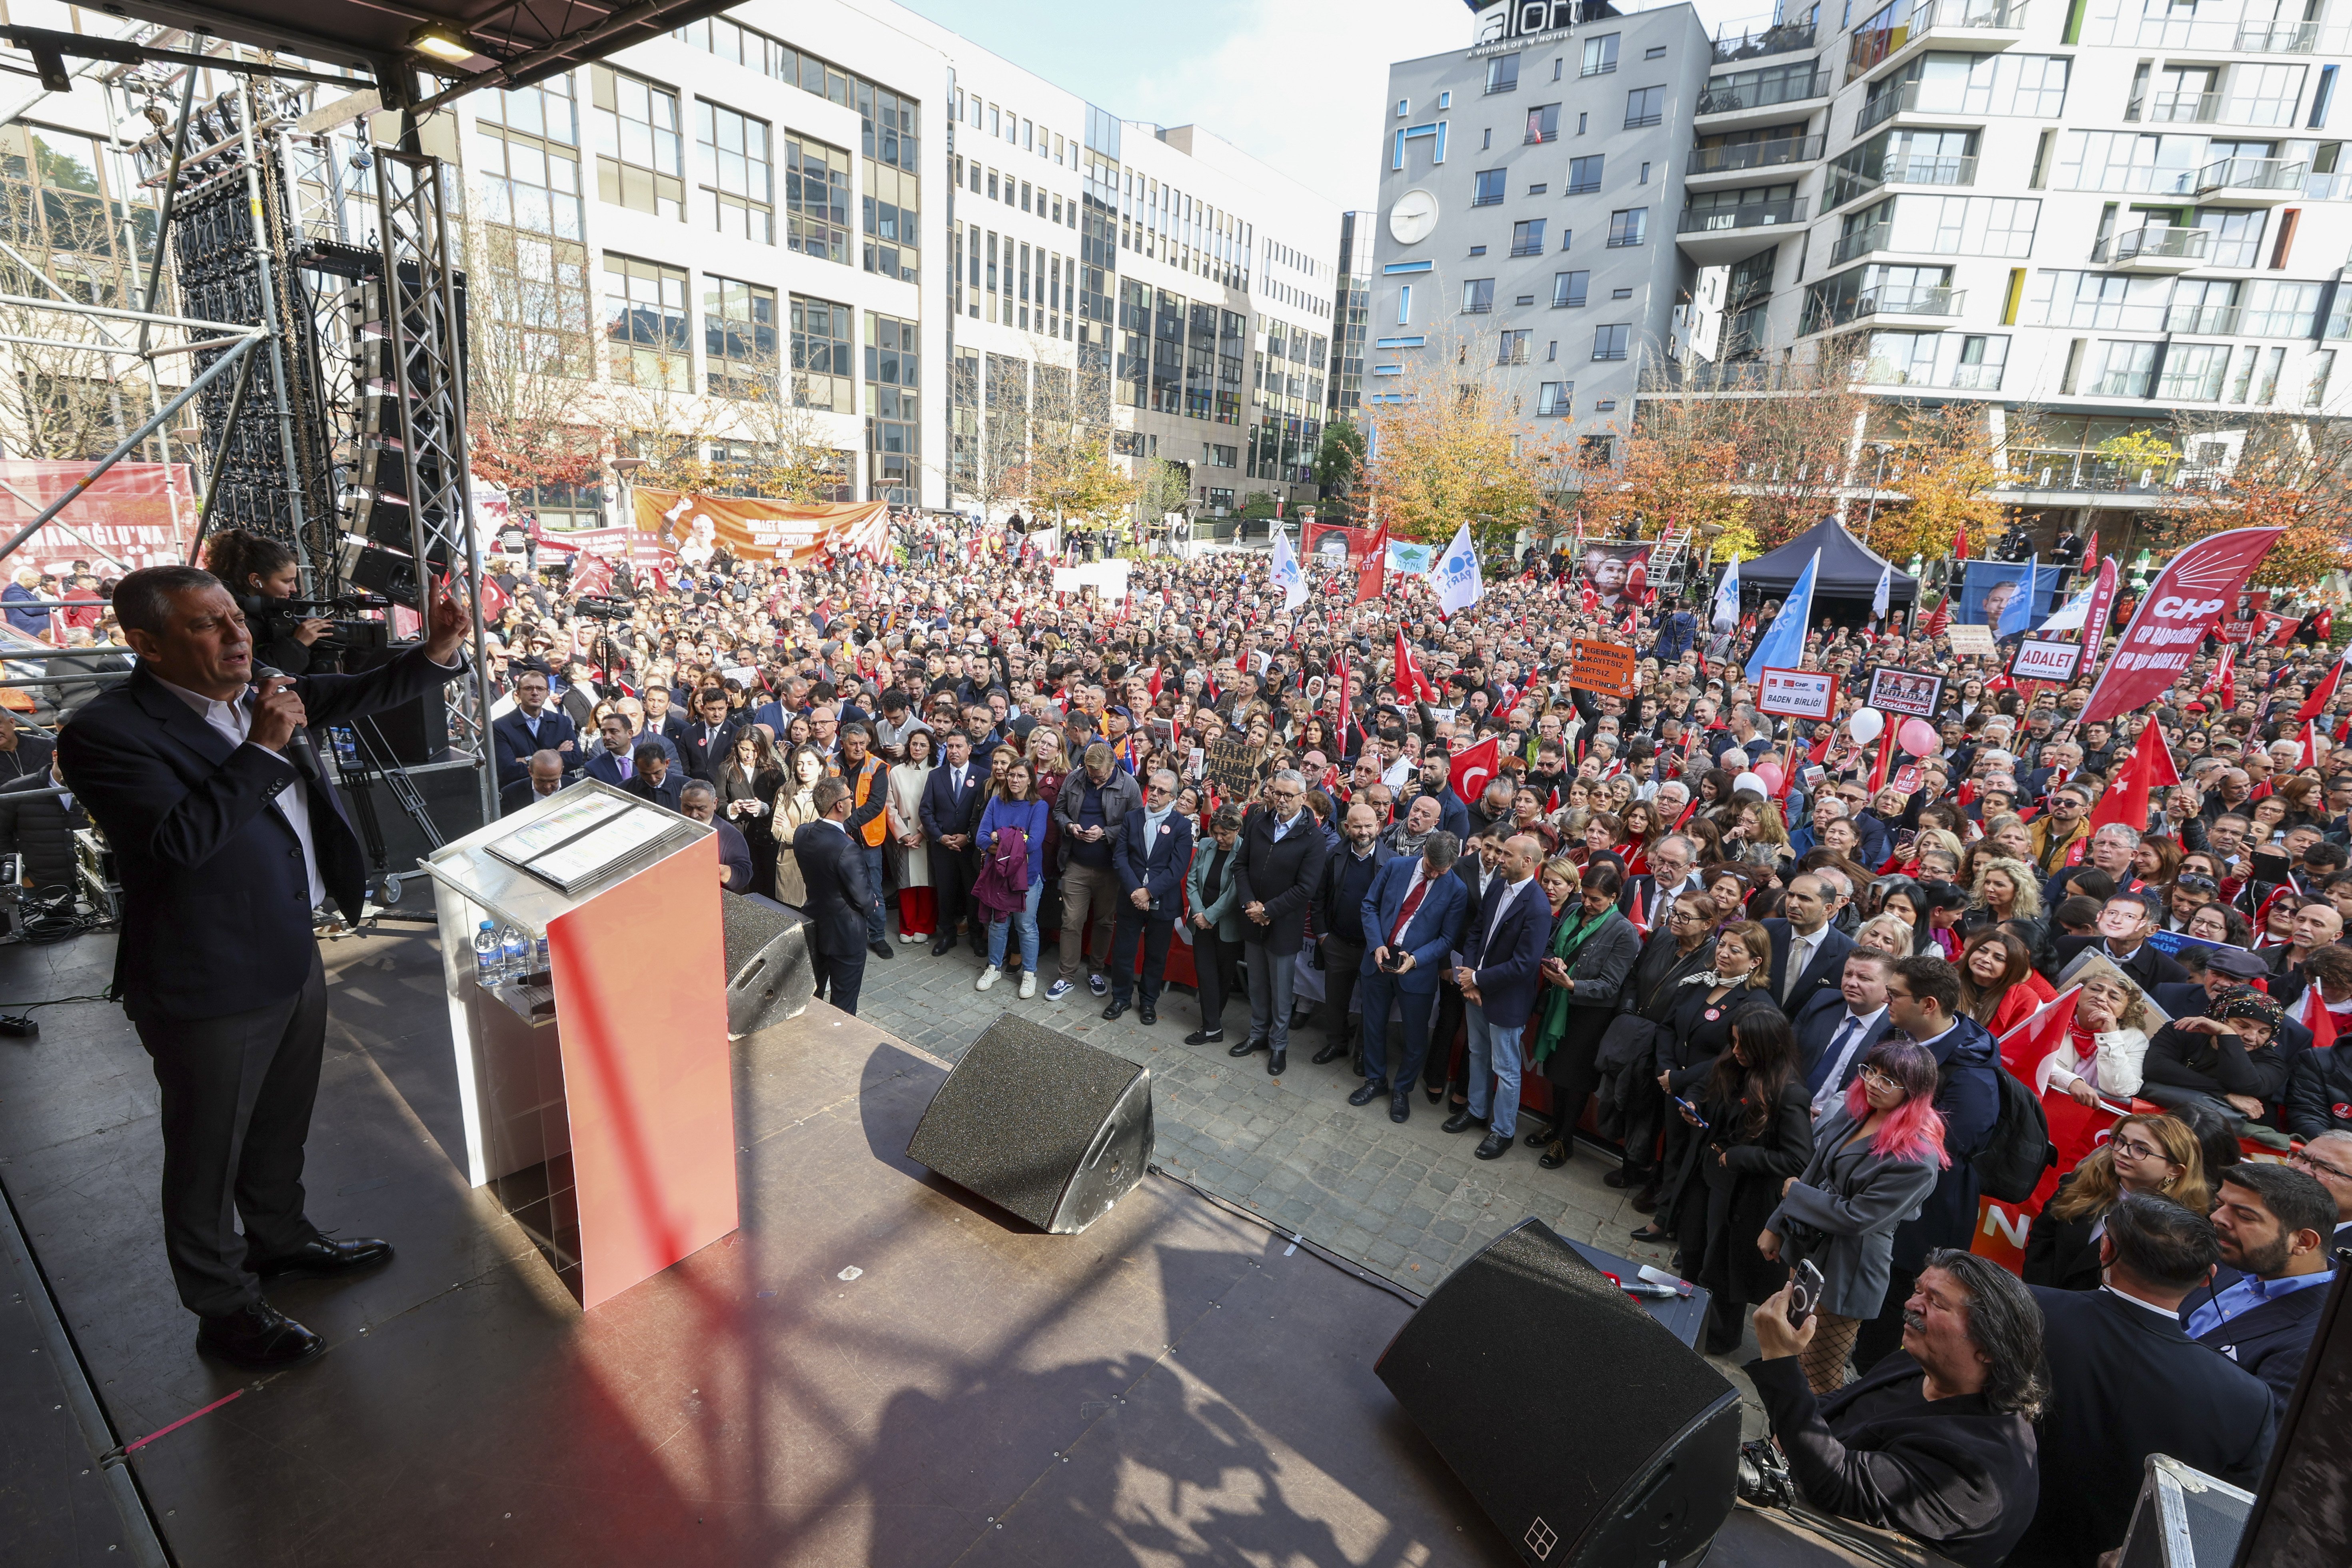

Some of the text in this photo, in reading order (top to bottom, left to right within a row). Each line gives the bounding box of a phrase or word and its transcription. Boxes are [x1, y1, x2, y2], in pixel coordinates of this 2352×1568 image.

[1477, 44, 1507, 56] VISION
[1511, 40, 1523, 48] OF
[1539, 30, 1574, 43] HOTELS
[2153, 596, 2224, 621] CHP
[2134, 625, 2154, 643] CHP
[1585, 647, 1628, 660] EGEMENLİK
[2021, 649, 2074, 668] ADALET
[2115, 651, 2136, 669] CHP
[1587, 656, 1623, 668] KAYITSIZ
[1575, 665, 1609, 677] ŞARTSIZ
[1572, 675, 1619, 690] MİLLETİNDİR
[1767, 695, 1822, 707] BADEN BİRLİĞİ
[1873, 698, 1929, 713] ÖZGÜRLÜK
[2148, 941, 2179, 954] GÜR
